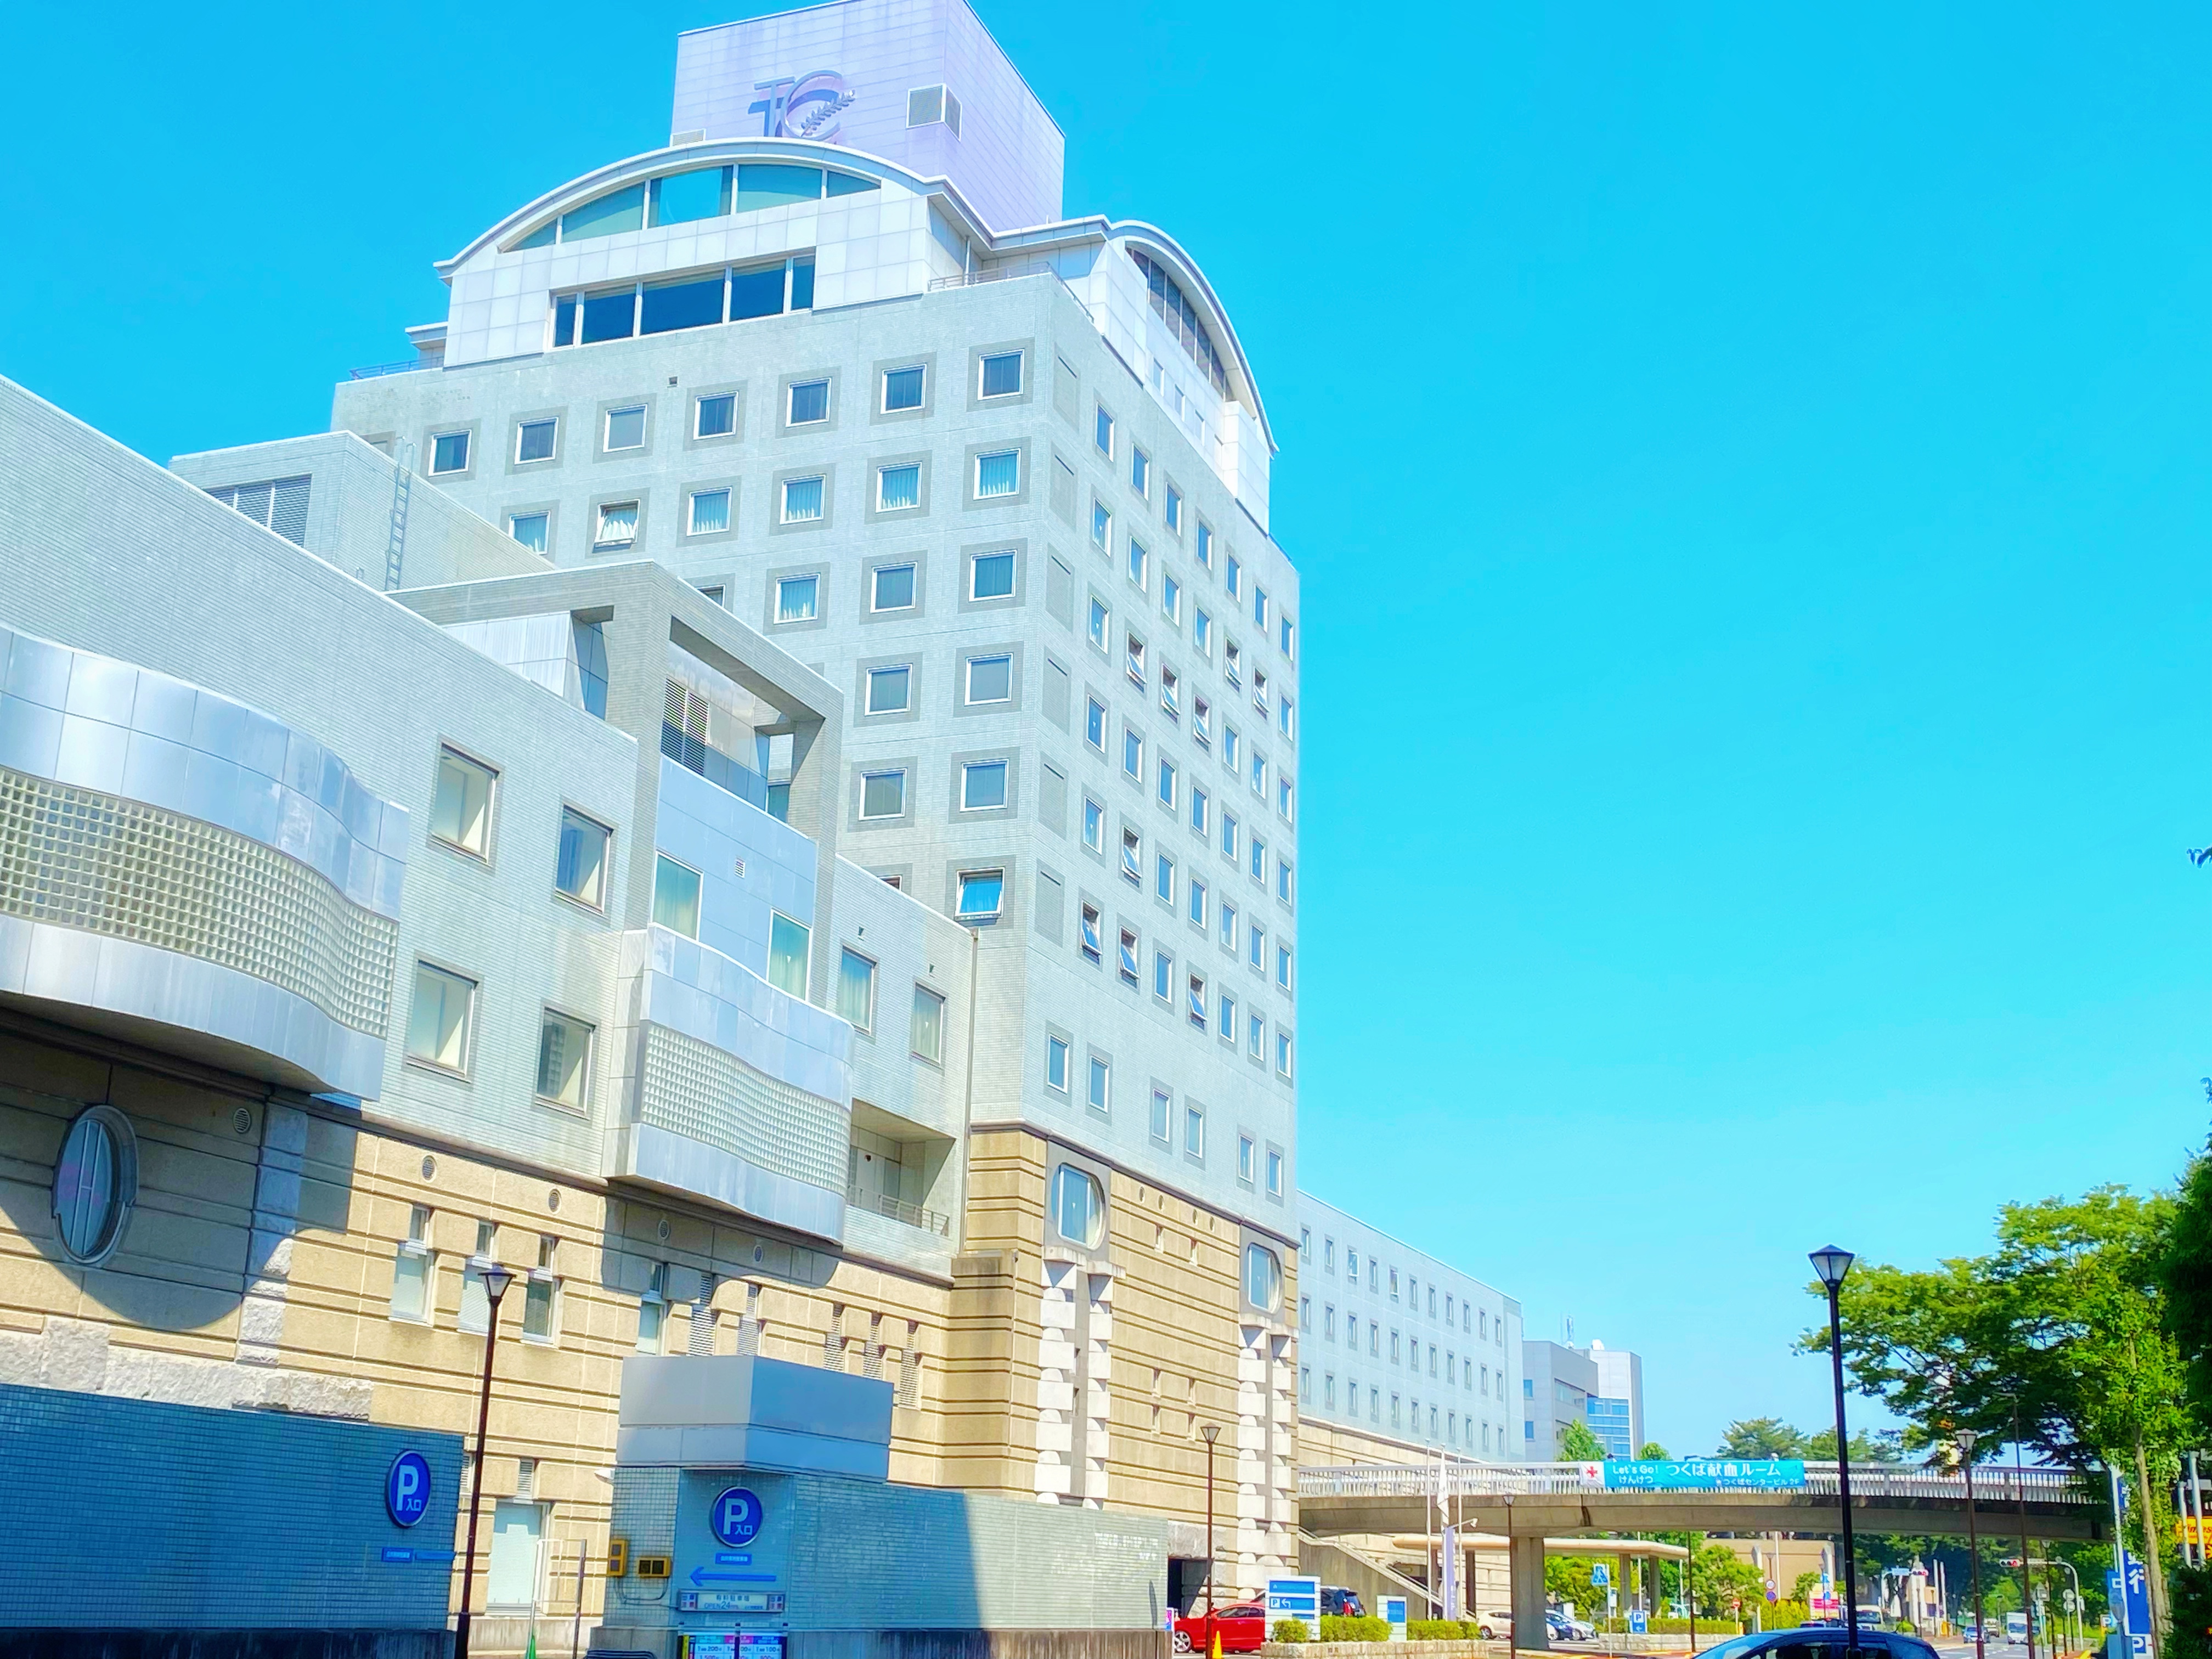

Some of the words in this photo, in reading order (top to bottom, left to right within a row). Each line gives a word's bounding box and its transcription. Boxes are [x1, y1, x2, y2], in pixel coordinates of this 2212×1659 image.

[1613, 1464, 1637, 1474] Let's
[1639, 1465, 1659, 1474] Go!
[1666, 1463, 1781, 1476] つくば献血ルーム
[1619, 1475, 1654, 1485] けんけつ
[396, 1465, 419, 1511] P
[406, 1498, 422, 1511] 入口
[723, 1498, 749, 1535] P
[735, 1524, 752, 1535] 入口
